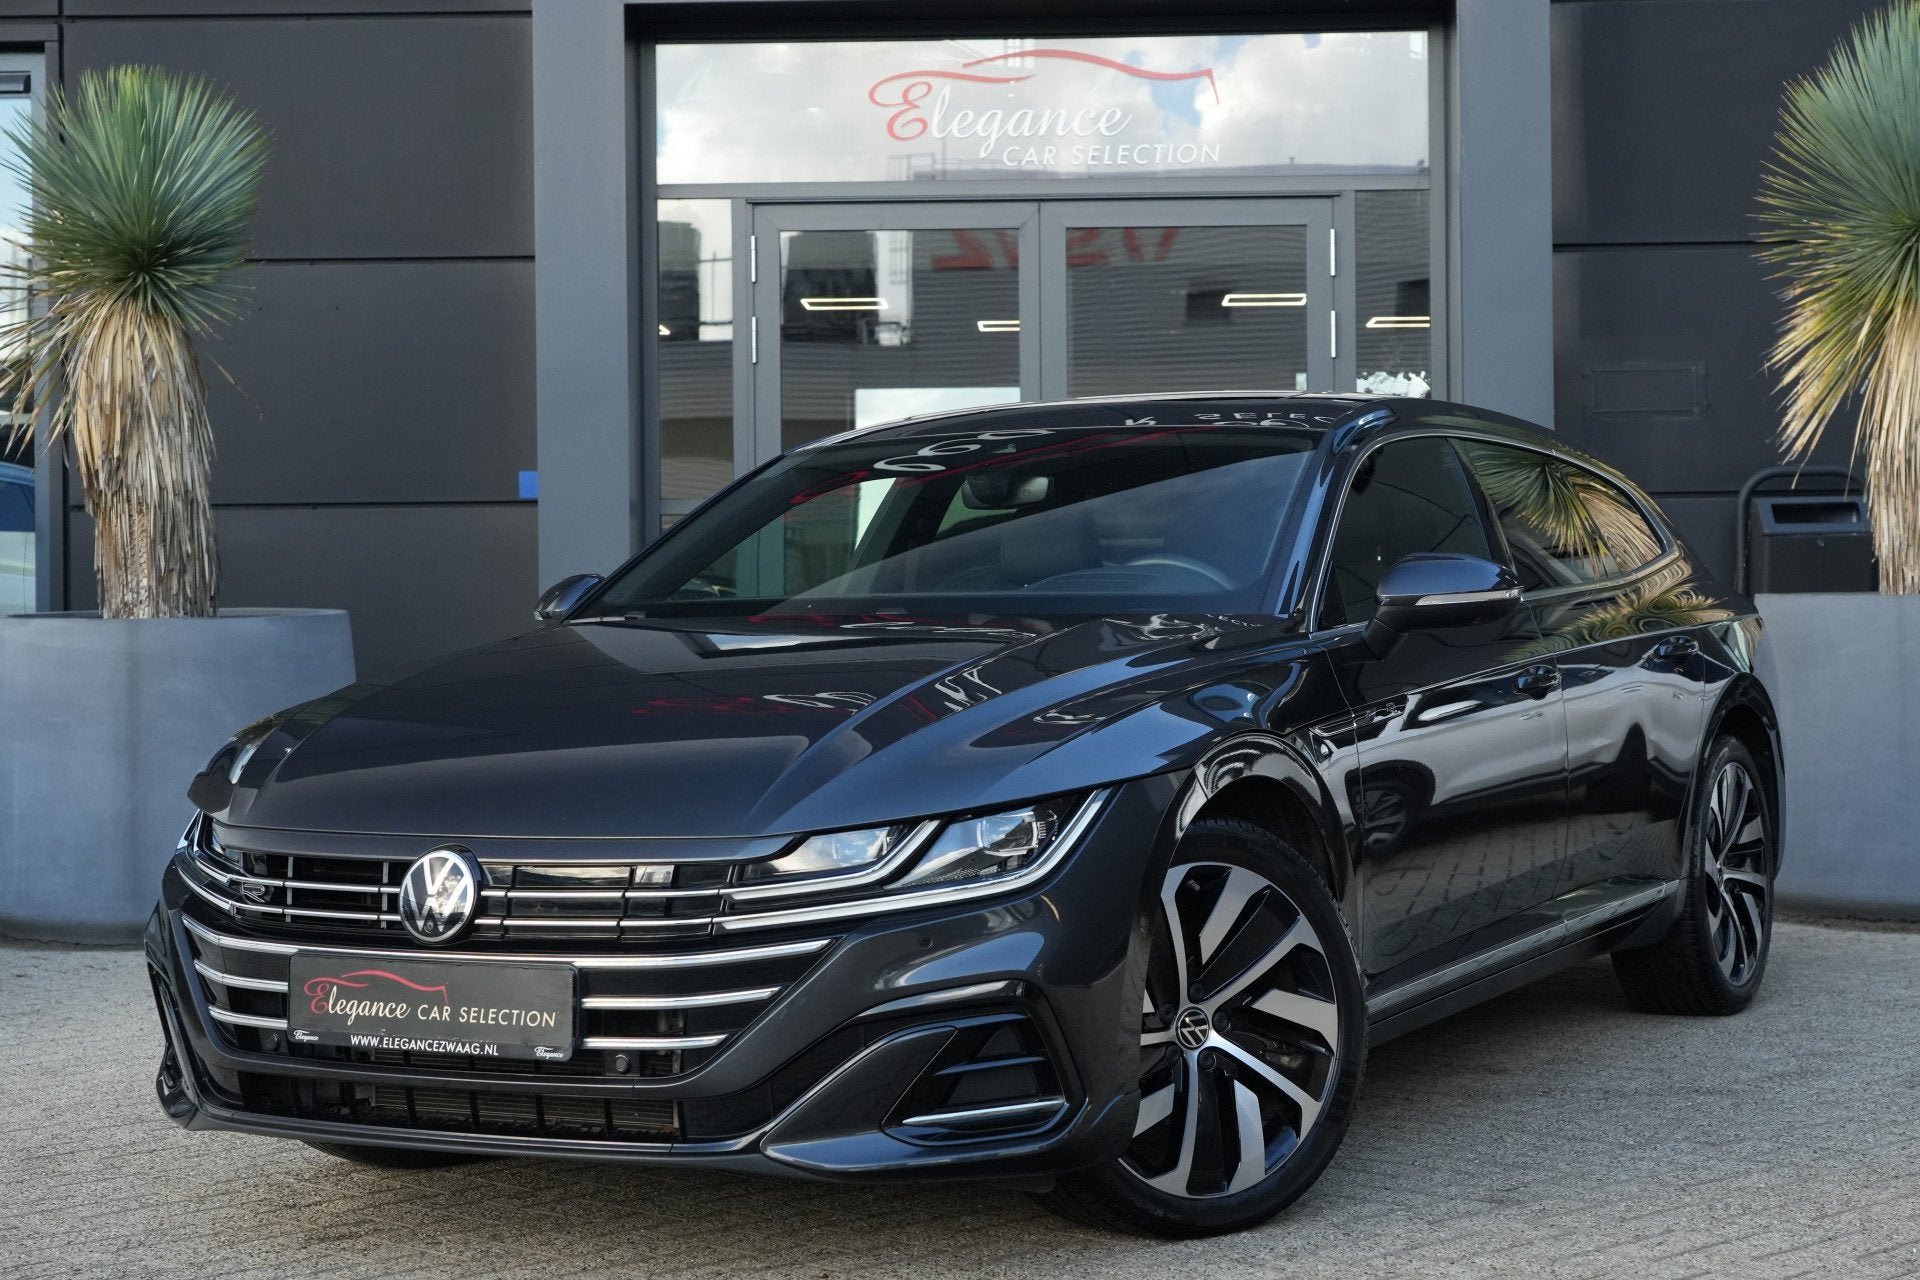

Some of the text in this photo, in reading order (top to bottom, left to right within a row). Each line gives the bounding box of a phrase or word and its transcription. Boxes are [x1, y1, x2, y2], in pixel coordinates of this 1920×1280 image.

[868, 71, 1132, 159] Elegance
[1002, 143, 1221, 167] CAR SELECTION
[303, 977, 557, 1028] Elegance CAR SELECTION
[350, 1034, 499, 1056] WWW.ELEGANCEZWAAG.NL
